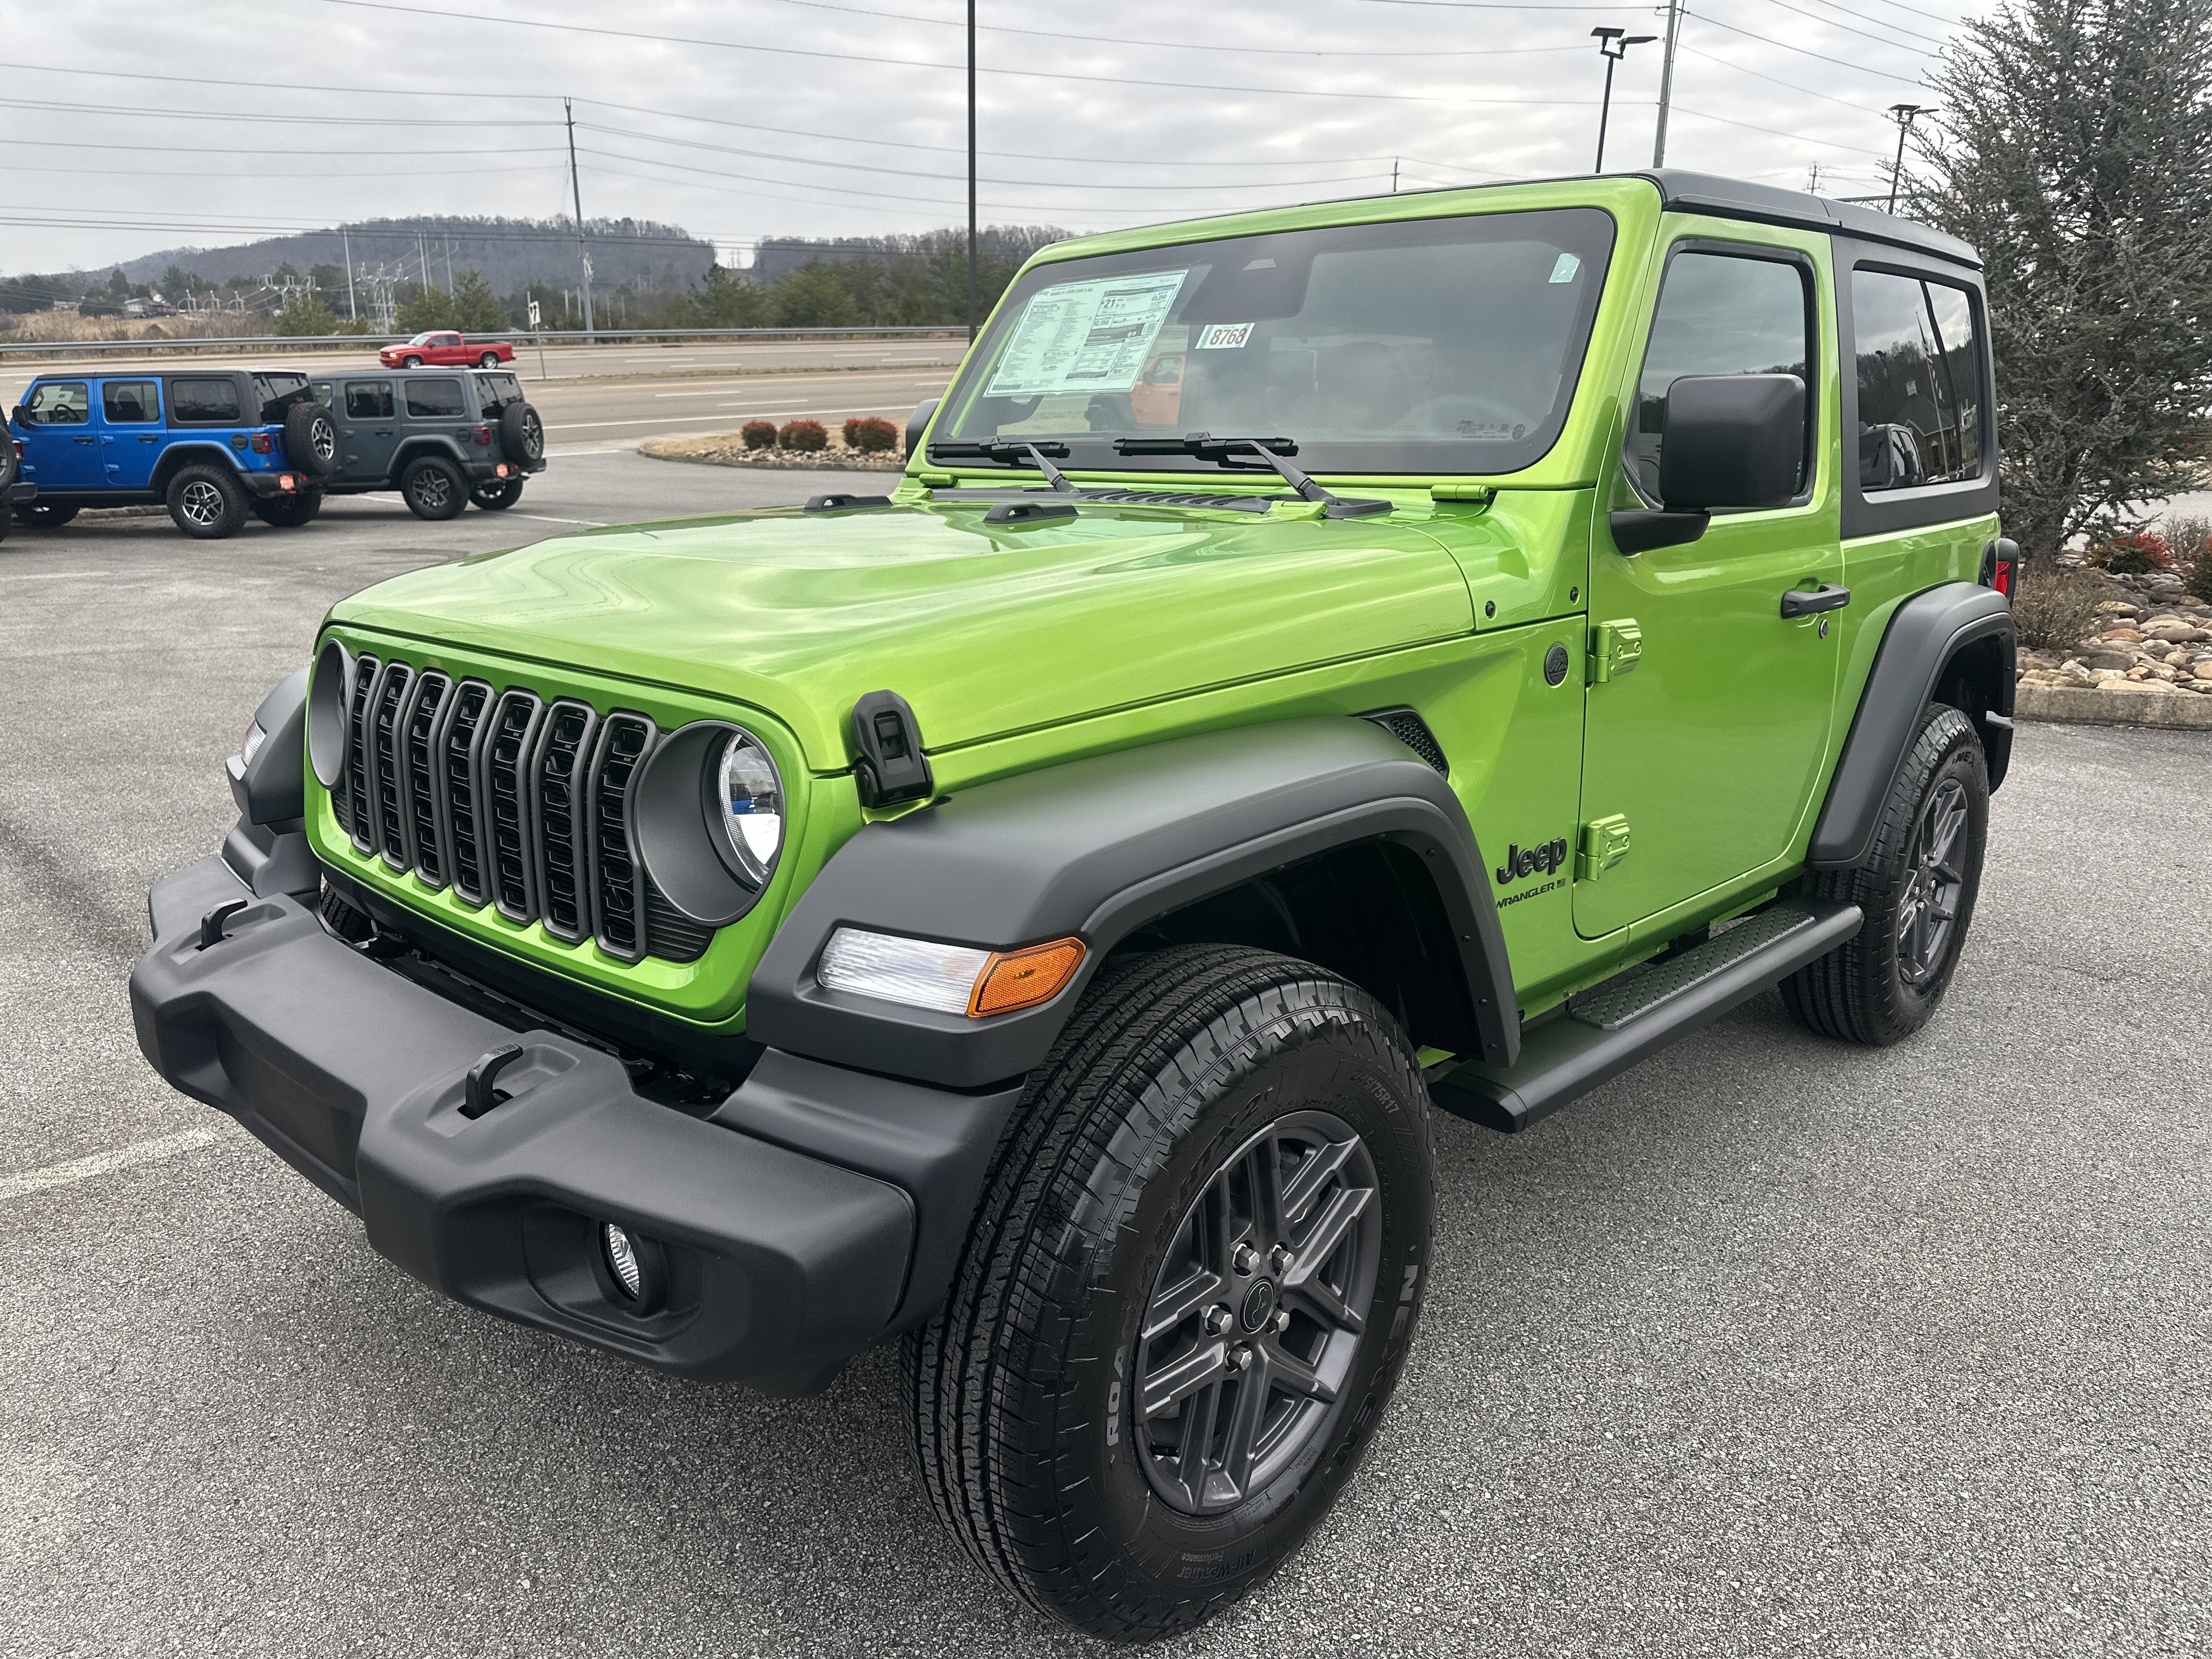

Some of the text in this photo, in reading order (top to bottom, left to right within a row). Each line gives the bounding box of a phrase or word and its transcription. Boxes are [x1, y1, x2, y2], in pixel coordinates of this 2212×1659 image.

[1104, 299, 1116, 308] 21
[1209, 328, 1248, 346] 8768
[1496, 836, 1567, 885] Jeep
[1496, 881, 1555, 909] WRANGLER
[1332, 1264, 1419, 1469] NEXEN
[1176, 1549, 1257, 1583] All-Weather
[1181, 1550, 1224, 1564] Performance
